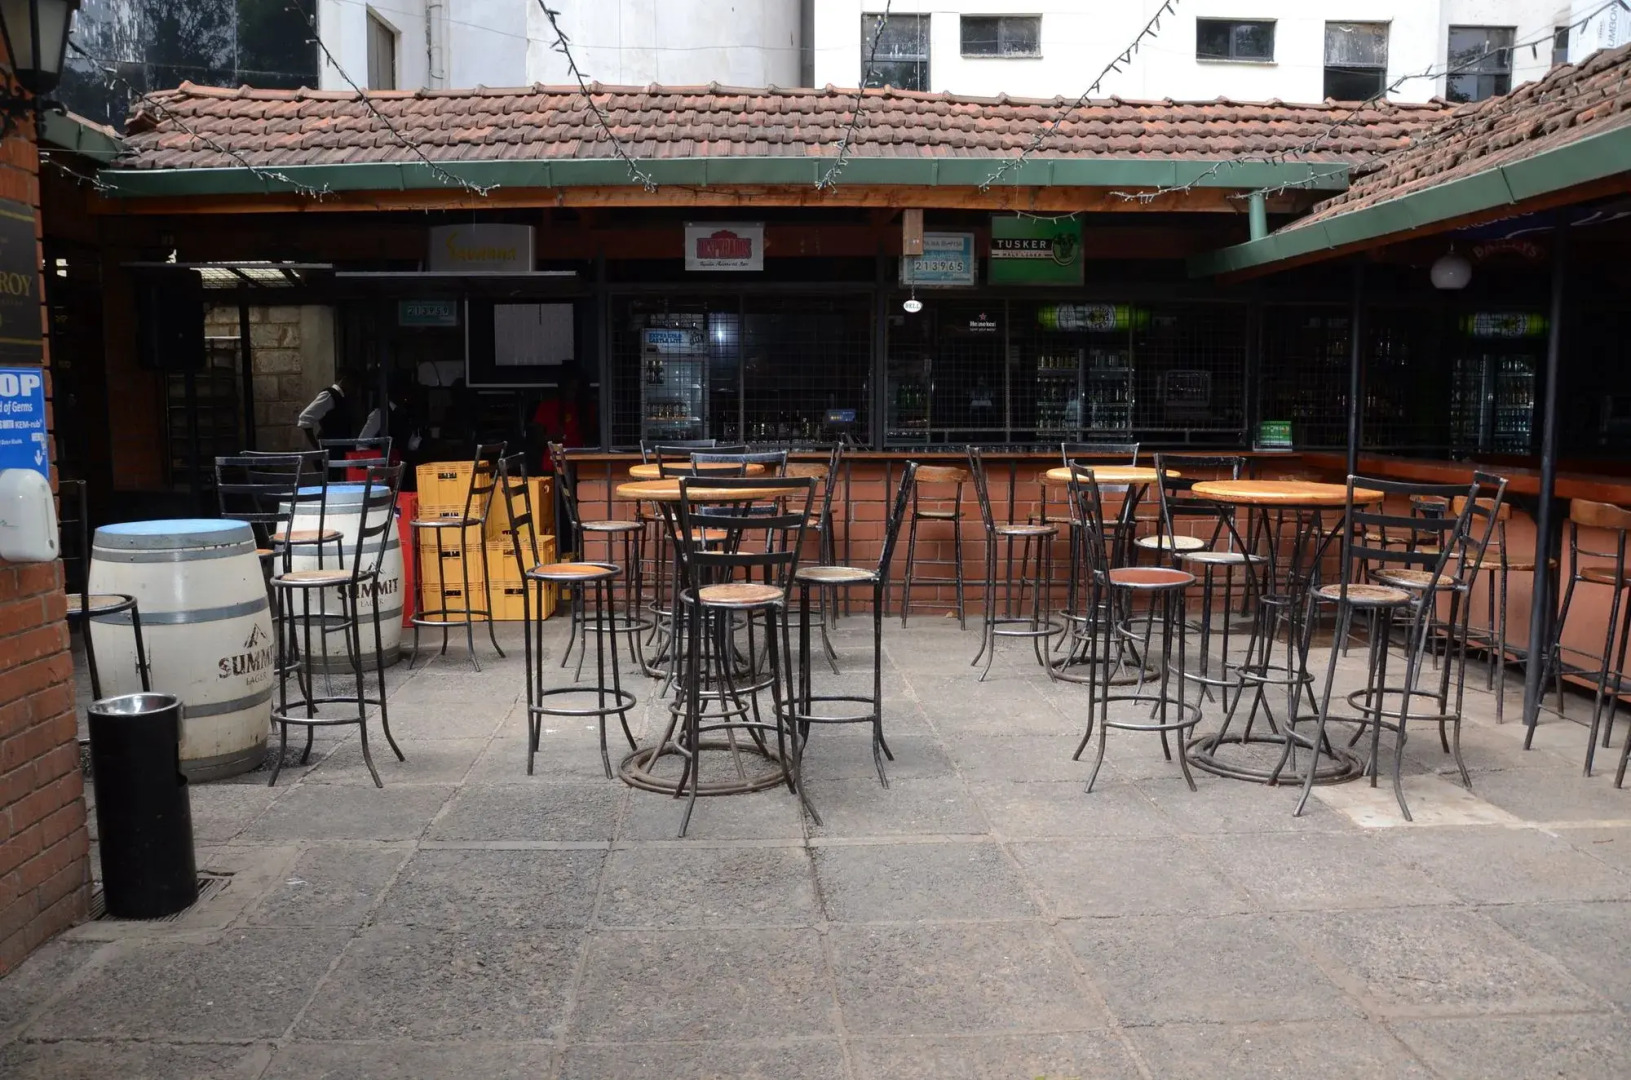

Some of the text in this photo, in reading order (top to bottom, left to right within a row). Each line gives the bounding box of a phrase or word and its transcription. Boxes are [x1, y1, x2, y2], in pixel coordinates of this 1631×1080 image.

[997, 240, 1046, 249] TUSKER
[914, 262, 964, 271] 213965
[4, 401, 10, 415] of
[12, 402, 33, 413] Germs
[218, 644, 274, 679] SUMMI
